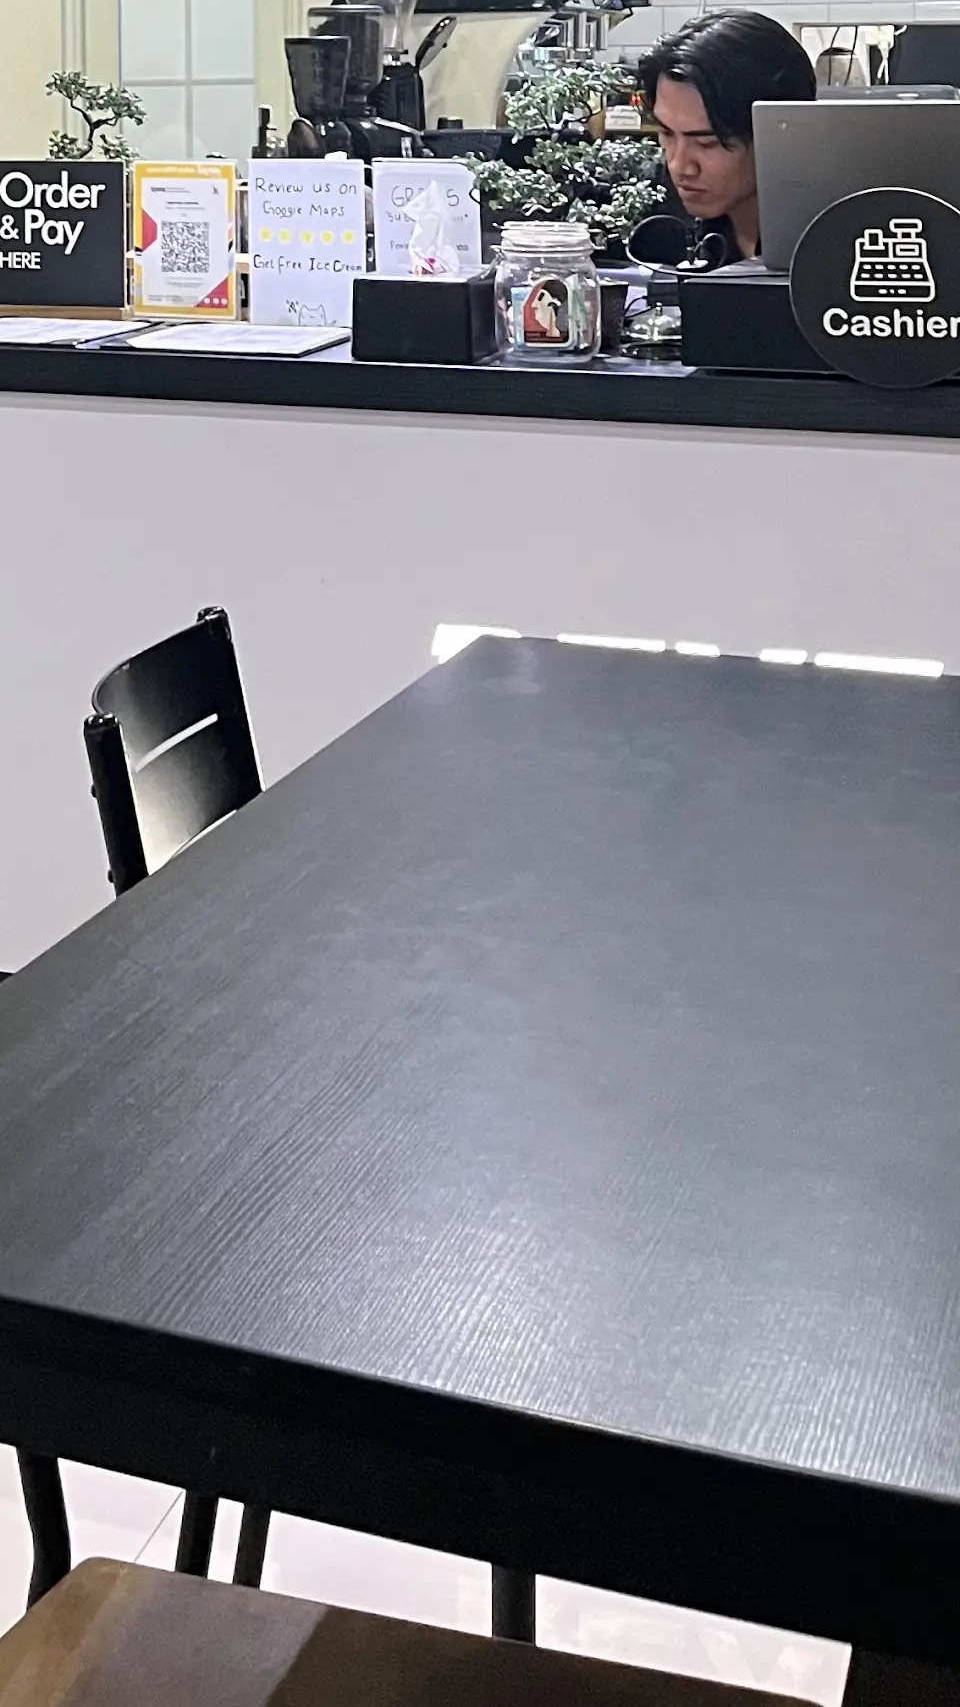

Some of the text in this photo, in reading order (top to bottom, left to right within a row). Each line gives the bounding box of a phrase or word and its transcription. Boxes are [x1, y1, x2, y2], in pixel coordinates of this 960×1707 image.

[0, 170, 106, 209] Order
[255, 177, 357, 194] Review us on
[391, 185, 460, 207] GRS
[309, 203, 345, 218] Maps
[0, 208, 85, 255] & Pay
[253, 254, 275, 269] Get
[309, 257, 330, 272] Ice
[333, 259, 363, 273] Cream
[822, 307, 960, 338] Cashier
